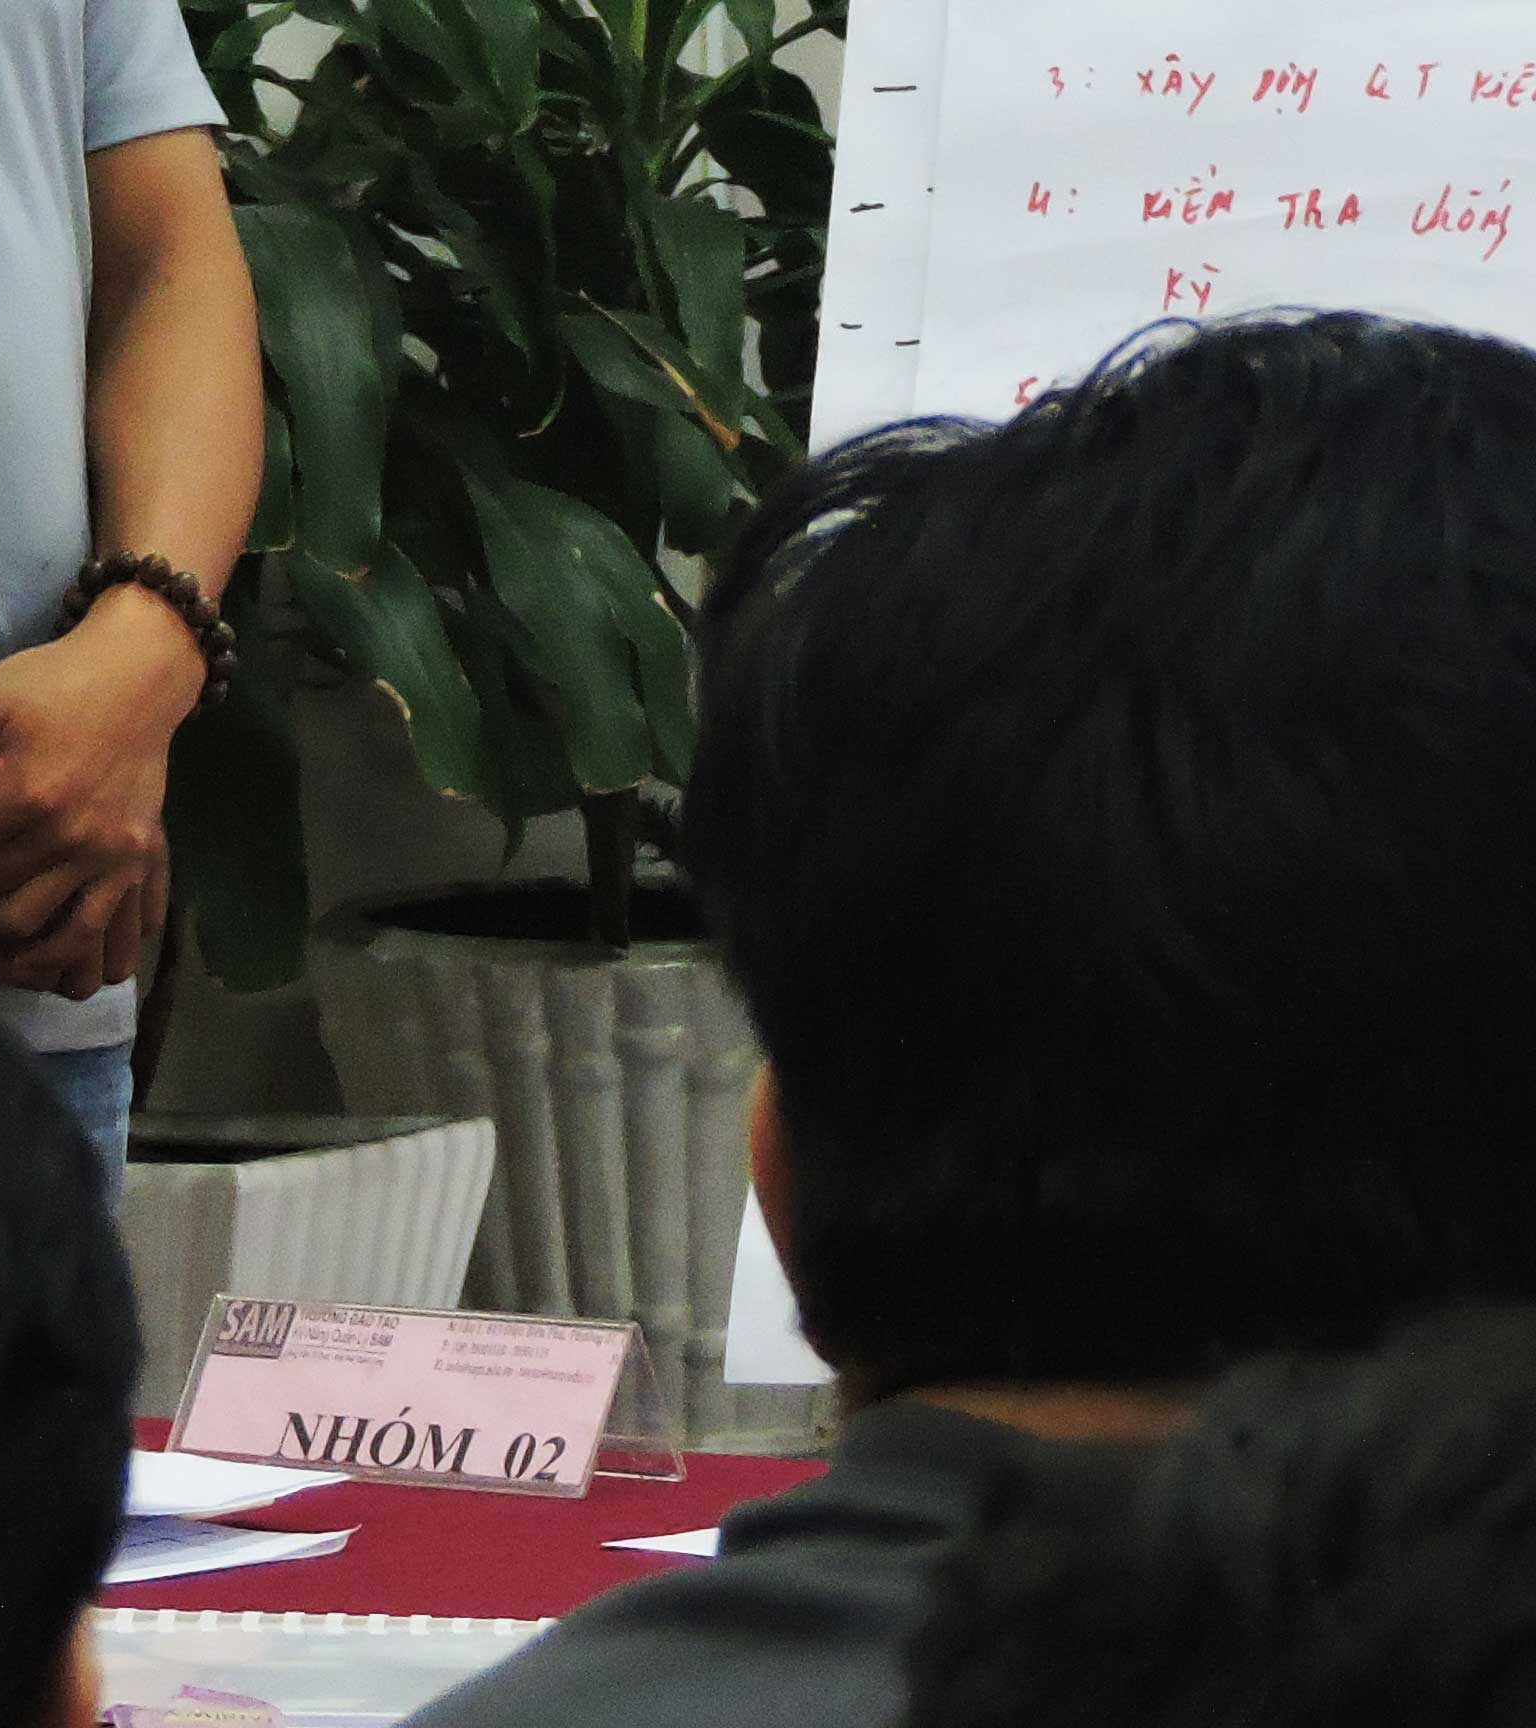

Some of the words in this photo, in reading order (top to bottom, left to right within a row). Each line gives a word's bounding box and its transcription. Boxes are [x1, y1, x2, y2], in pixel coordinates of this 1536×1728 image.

[219, 1301, 291, 1345] SAM
[275, 1406, 476, 1473] NHÓM
[503, 1432, 566, 1482] 02
